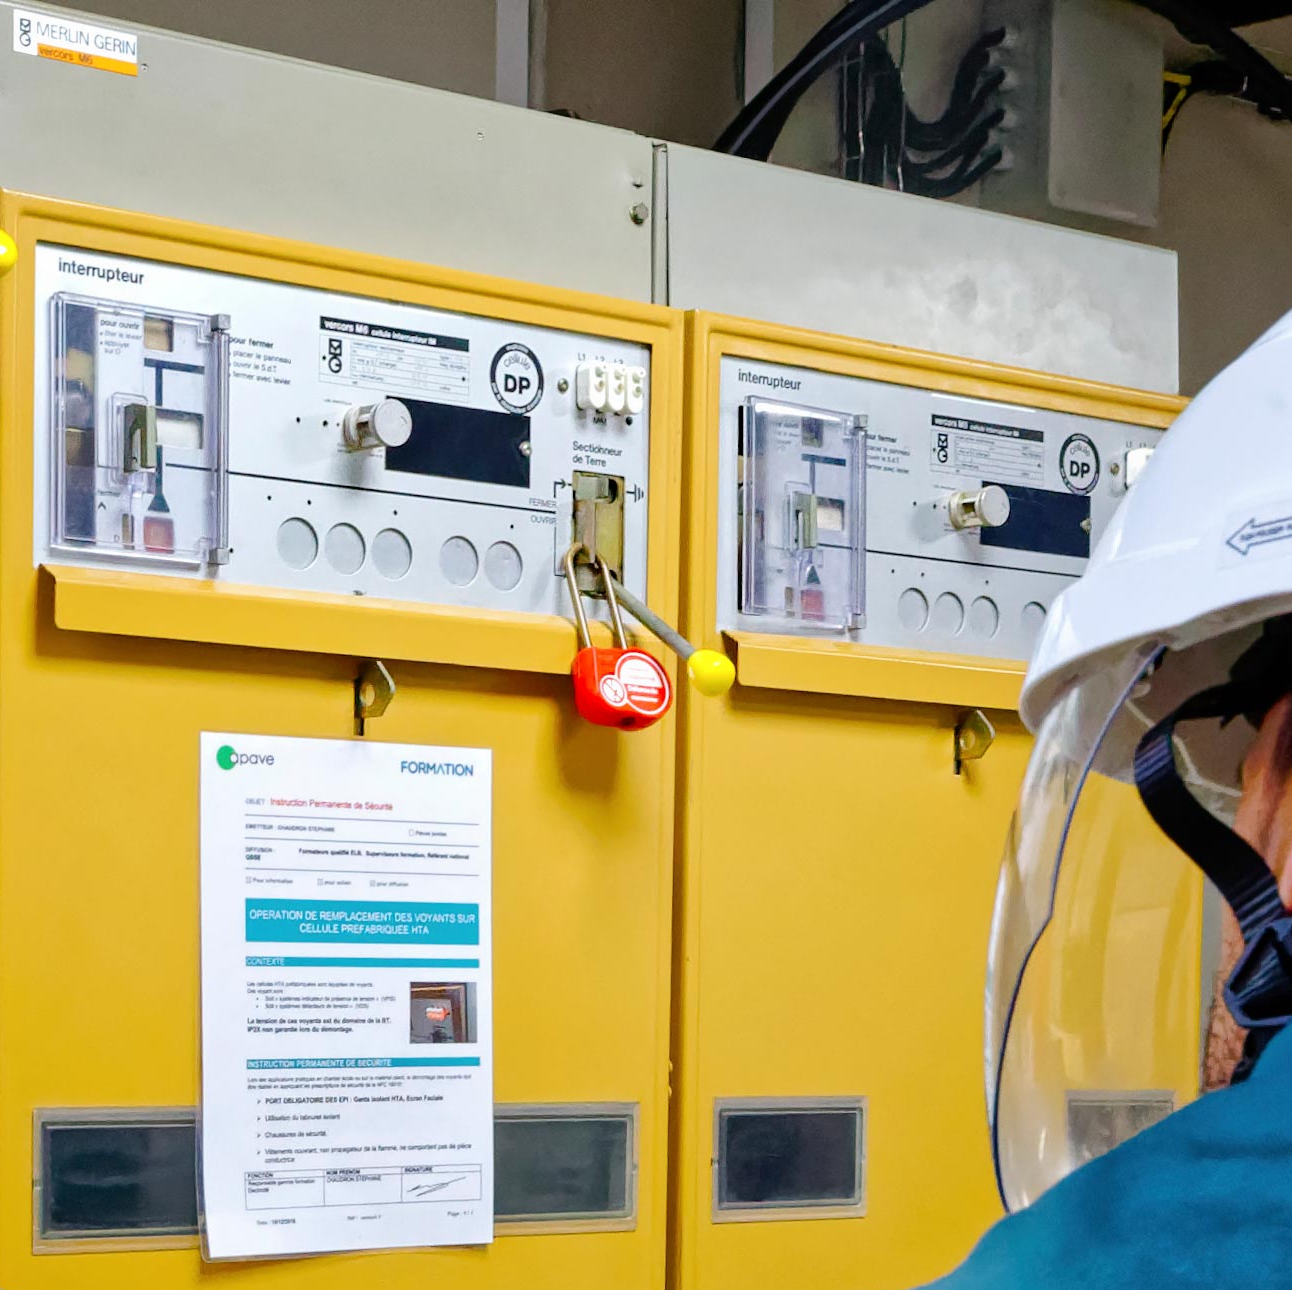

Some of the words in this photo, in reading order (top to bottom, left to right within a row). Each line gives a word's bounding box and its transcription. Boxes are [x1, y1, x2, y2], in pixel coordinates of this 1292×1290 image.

[37, 21, 89, 46] MERLIN
[93, 34, 136, 56] GERIN
[58, 258, 145, 285] interrupteur
[323, 319, 355, 333] vercors
[249, 337, 274, 349] fermer
[577, 353, 586, 362] L1
[503, 374, 531, 395] DP
[738, 368, 801, 391] interrupteur
[572, 440, 623, 457] Sectionneur
[572, 455, 583, 464] de
[585, 455, 607, 468] Terre
[1070, 460, 1091, 478] DP
[229, 751, 275, 766] apave
[400, 760, 475, 777] FORMATION
[269, 798, 307, 808] Instruction
[309, 799, 353, 810] Permanente
[354, 801, 363, 810] de
[365, 801, 393, 812] Sécurité
[249, 908, 303, 922] OPERATION
[305, 910, 318, 922] DE
[319, 910, 393, 923] REMPLACEMENT
[395, 912, 413, 923] DES
[415, 912, 456, 924] VOYANTS
[457, 914, 476, 924] SUR
[299, 922, 339, 934] CELLULE
[341, 924, 409, 936] PREFABRIQUEE
[411, 924, 430, 935] HTA
[245, 957, 285, 967] CONTEXTE
[247, 1060, 295, 1068] INSTRUCTION
[296, 1058, 345, 1068] PERMANENTE
[346, 1058, 355, 1067] DE
[356, 1058, 392, 1067] SECURITE
